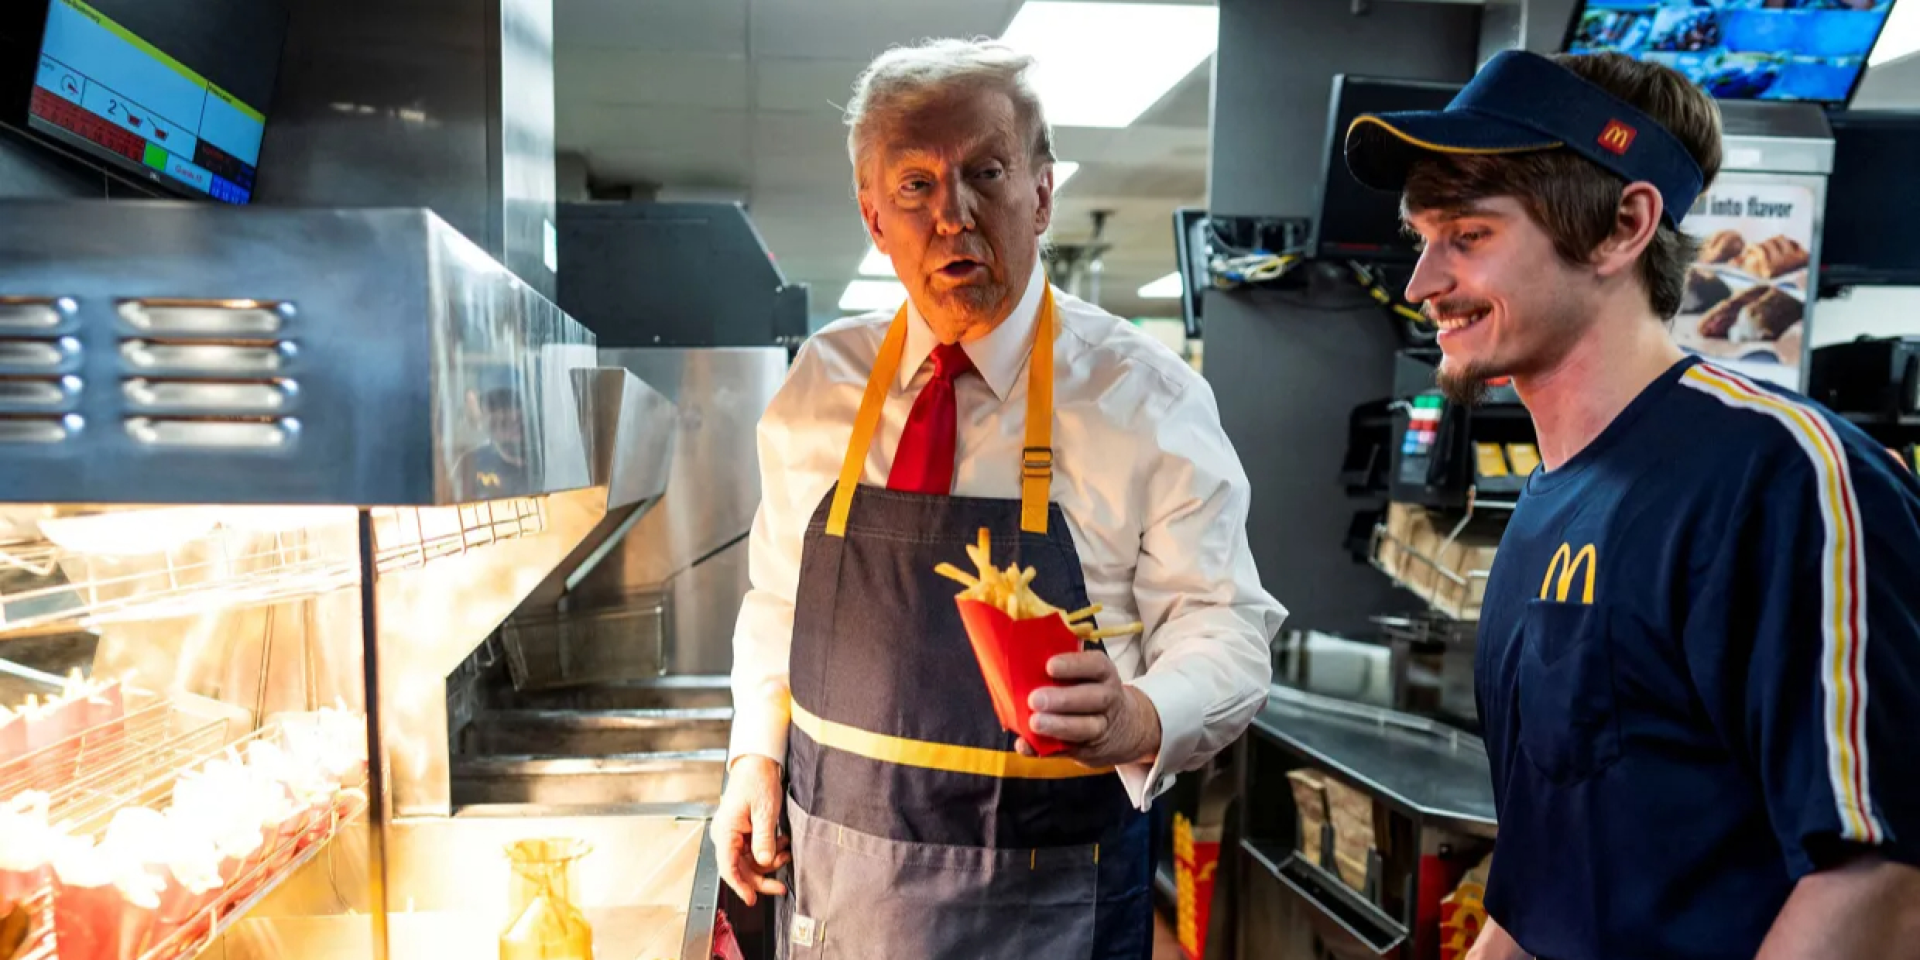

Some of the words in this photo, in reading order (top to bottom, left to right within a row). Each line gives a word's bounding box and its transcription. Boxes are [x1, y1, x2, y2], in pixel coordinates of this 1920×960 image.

[107, 98, 117, 115] 2
[1711, 195, 1743, 217] into
[1747, 195, 1793, 218] flavor
